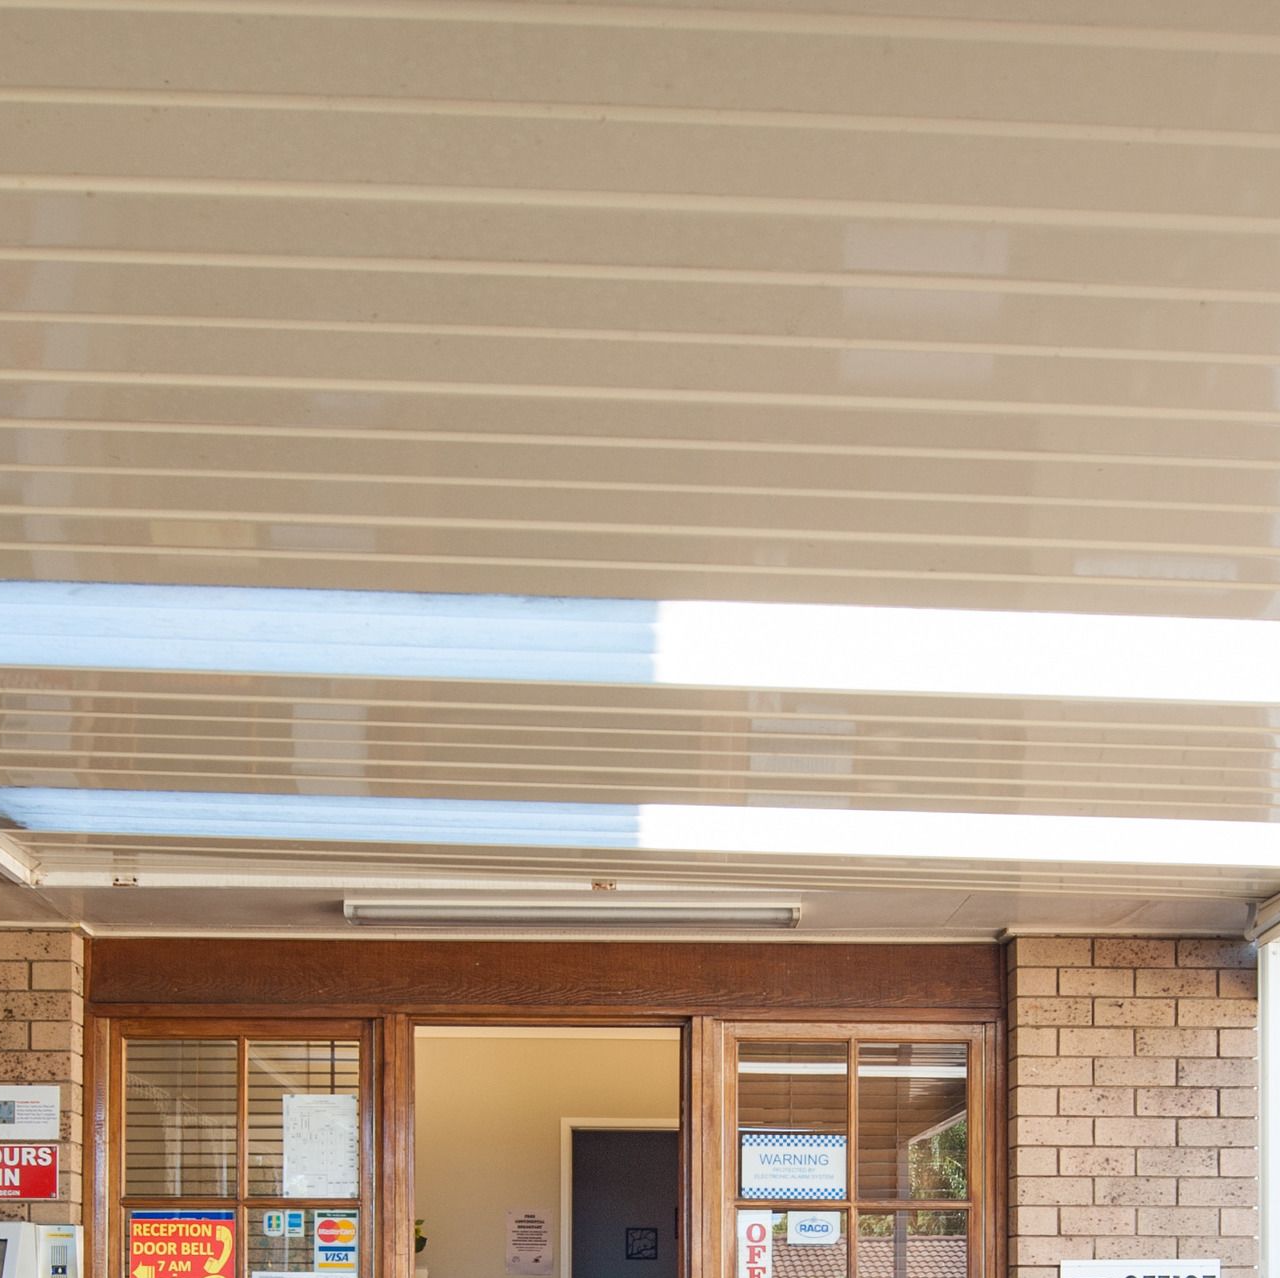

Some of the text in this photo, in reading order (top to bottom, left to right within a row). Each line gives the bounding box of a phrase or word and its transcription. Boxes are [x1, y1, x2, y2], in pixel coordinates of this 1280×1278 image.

[759, 1153, 829, 1166] WARNING
[133, 1223, 212, 1237] RECEPTION
[133, 1242, 214, 1255] DOOR BELL
[324, 1252, 349, 1262] VISA
[158, 1260, 191, 1271] 7 AM
